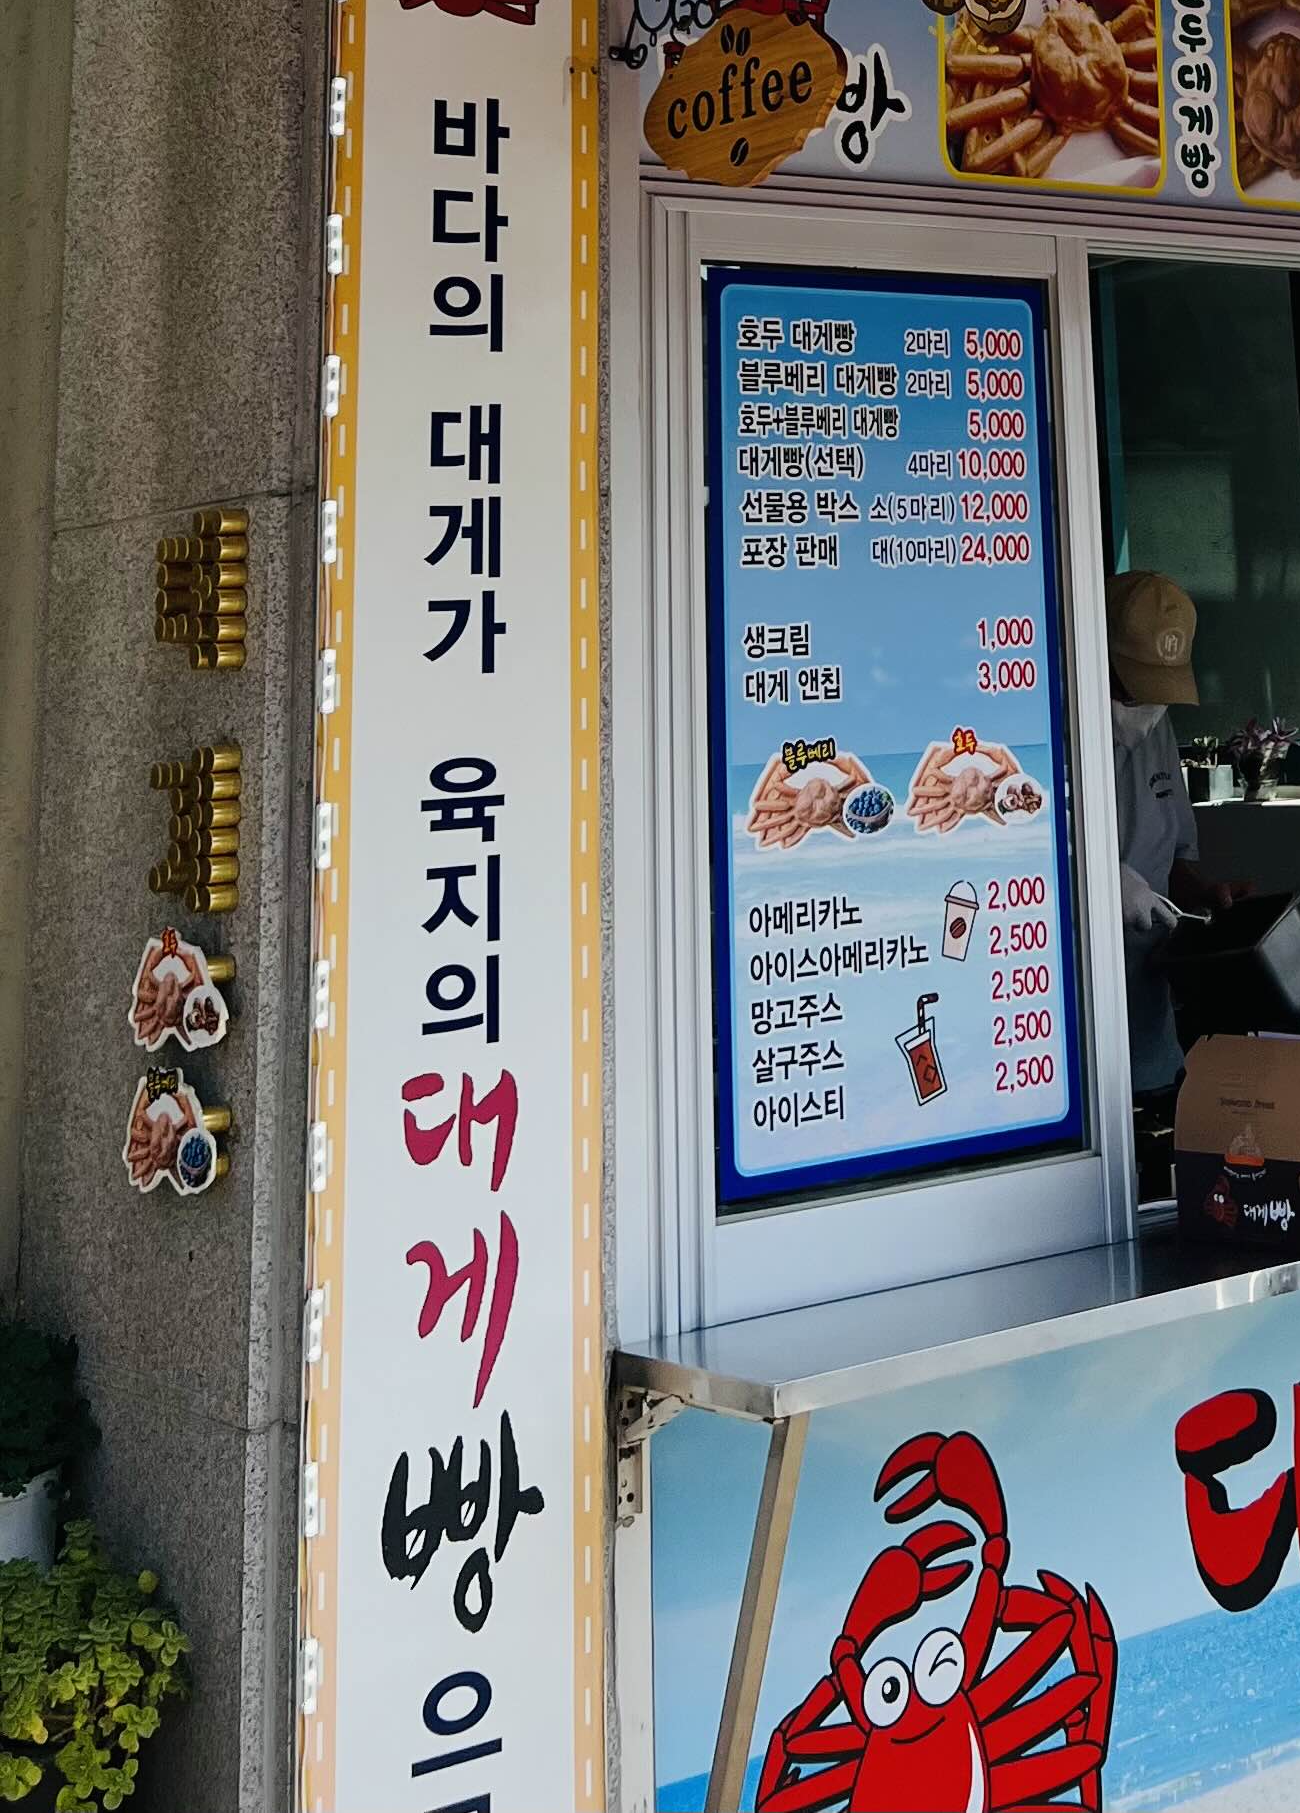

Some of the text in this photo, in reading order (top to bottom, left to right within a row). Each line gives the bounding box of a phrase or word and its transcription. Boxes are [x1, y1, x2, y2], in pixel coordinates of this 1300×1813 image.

[667, 56, 813, 139] coffee
[429, 97, 510, 353] 바다의
[738, 318, 1022, 359] 호두 대게빵 2마리 5,000
[739, 361, 1022, 400] 블루베리 대게빵 2마리 5,000
[739, 404, 1024, 441] 호두+블루베리 대게빵 5,000
[739, 445, 1026, 481] 대게빵(선택) 4마리 10,000
[741, 491, 1028, 524] 선물용 박스 소(5마리) 12,000
[423, 403, 507, 674] 대게가
[741, 534, 1030, 568] 포장 판매 대(10마리) 24,000
[743, 618, 1033, 658] 생크림 1,000
[744, 660, 1035, 703] 대게 앤칩 3,000
[784, 739, 835, 771] 블루베리
[420, 757, 505, 1044] 육지의
[749, 876, 1045, 938] 아메리카노 2,000
[750, 921, 1047, 986] 아이스아메리카노 2,500
[751, 965, 1049, 1035] 망고주스 2,500
[752, 1010, 1051, 1085] 살구주스 2,500
[753, 1055, 1053, 1131] 아이스티 2,500
[1243, 1198, 1295, 1231] 대게빵
[381, 1069, 545, 1813] 대게빵으
